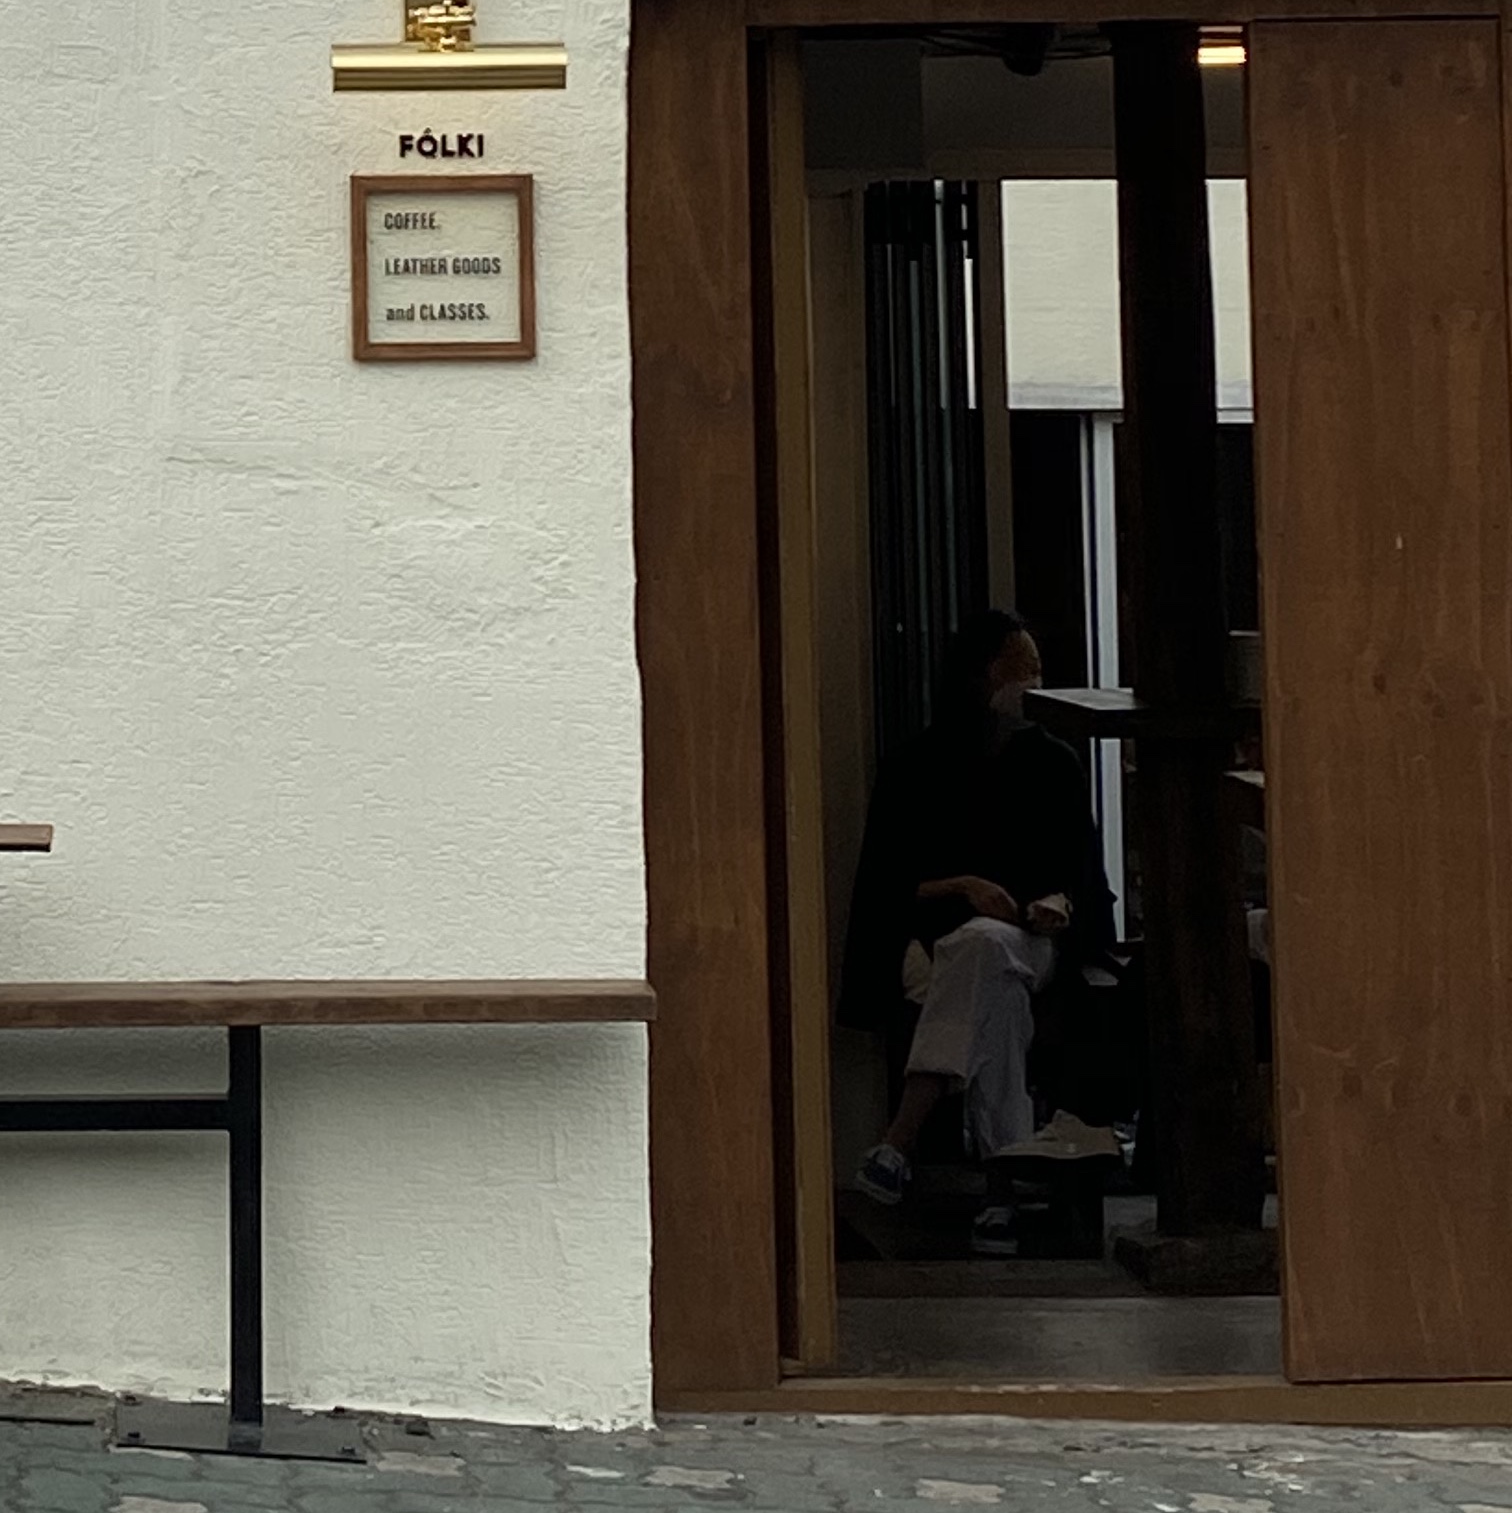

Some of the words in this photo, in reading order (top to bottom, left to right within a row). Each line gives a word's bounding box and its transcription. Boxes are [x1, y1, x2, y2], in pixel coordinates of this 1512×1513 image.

[399, 127, 484, 158] FÓLKI
[385, 257, 448, 276] LEATHER
[452, 257, 501, 275] GOODS
[386, 303, 415, 321] and
[420, 303, 490, 321] CLASSES.
